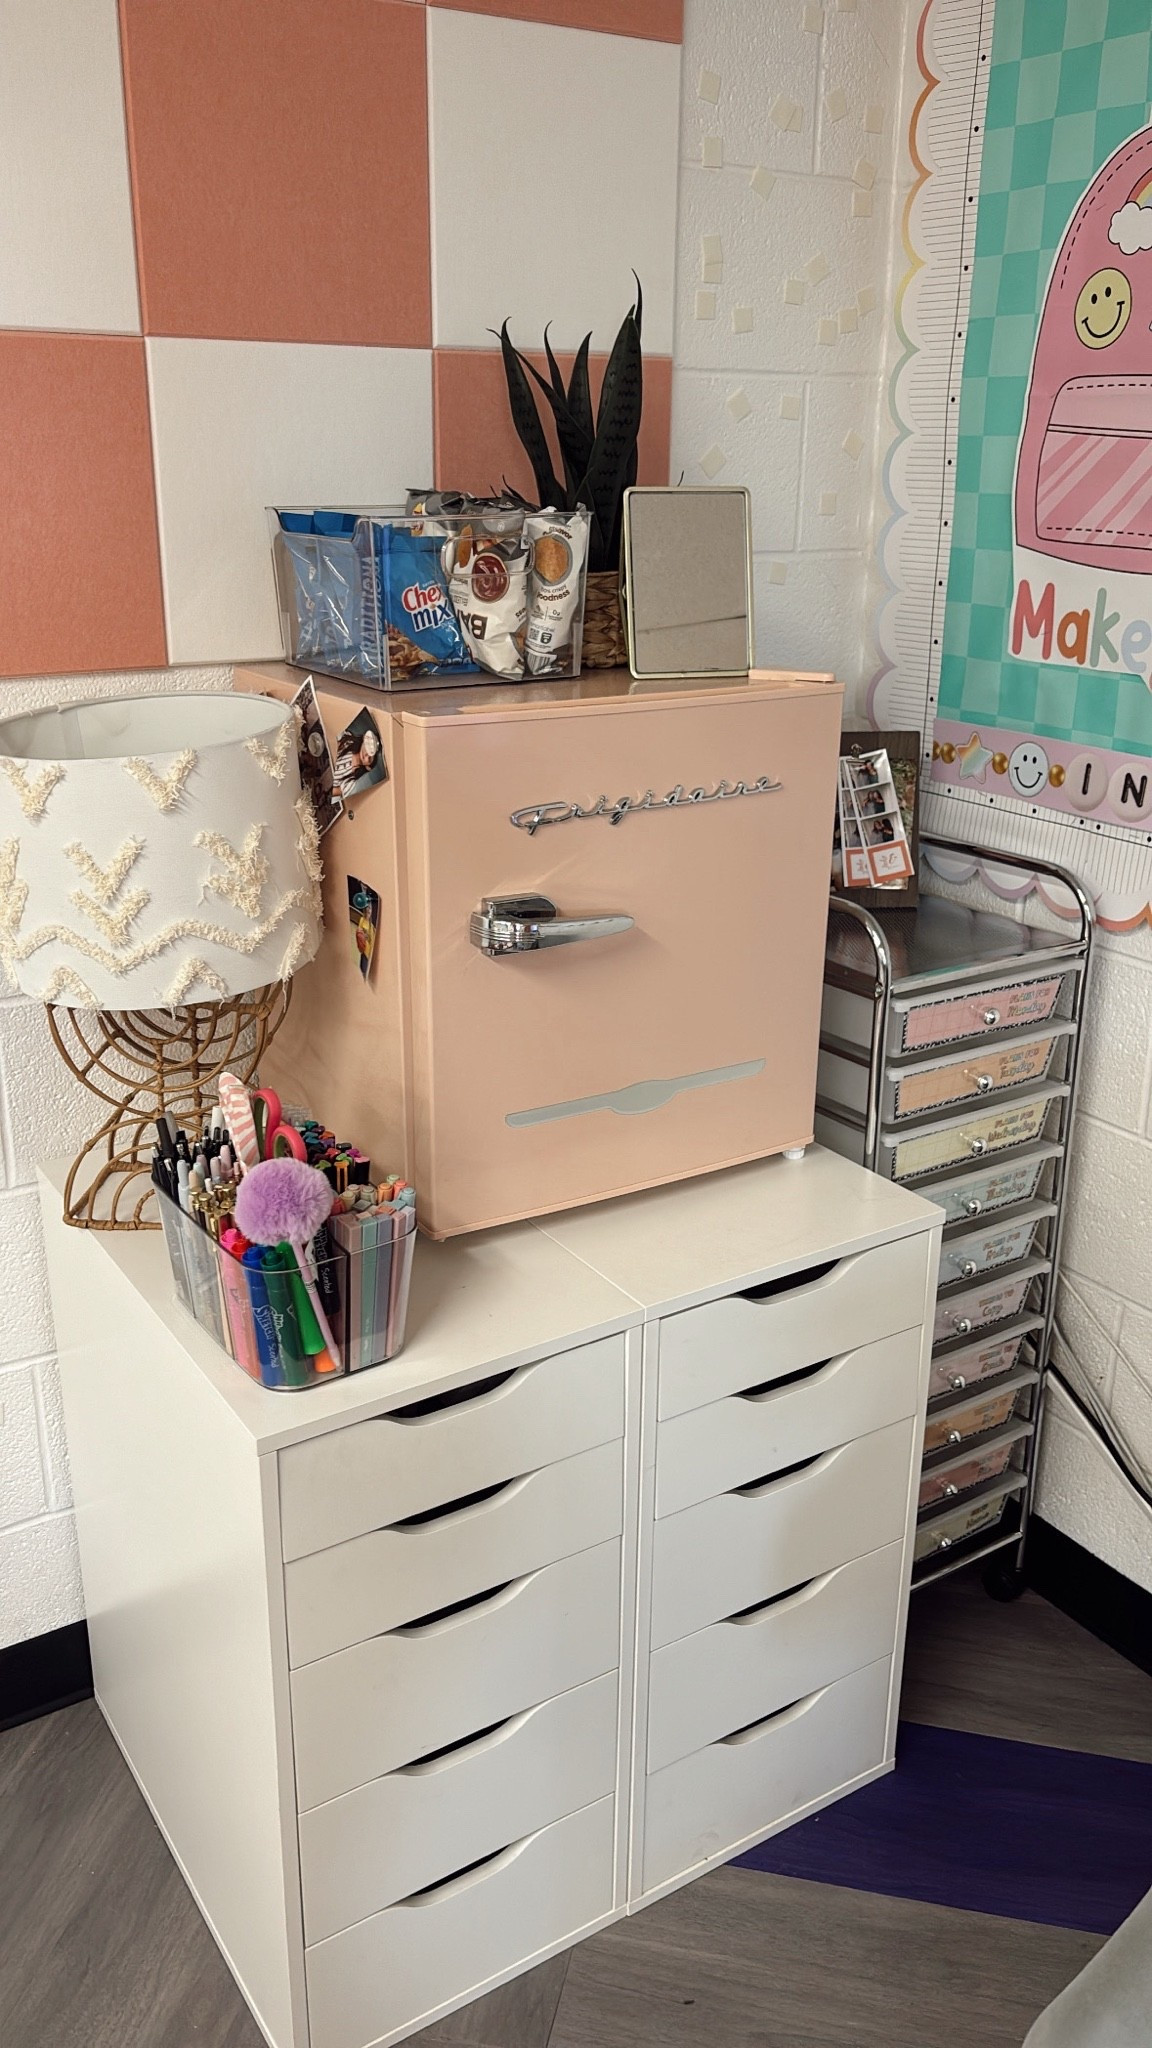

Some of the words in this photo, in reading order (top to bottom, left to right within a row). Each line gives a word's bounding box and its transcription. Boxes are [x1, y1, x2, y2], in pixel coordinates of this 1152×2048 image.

[413, 600, 452, 632] mix
[1011, 579, 1152, 674] Make
[509, 775, 783, 836] Frigidaire
[1081, 762, 1148, 808] IN
